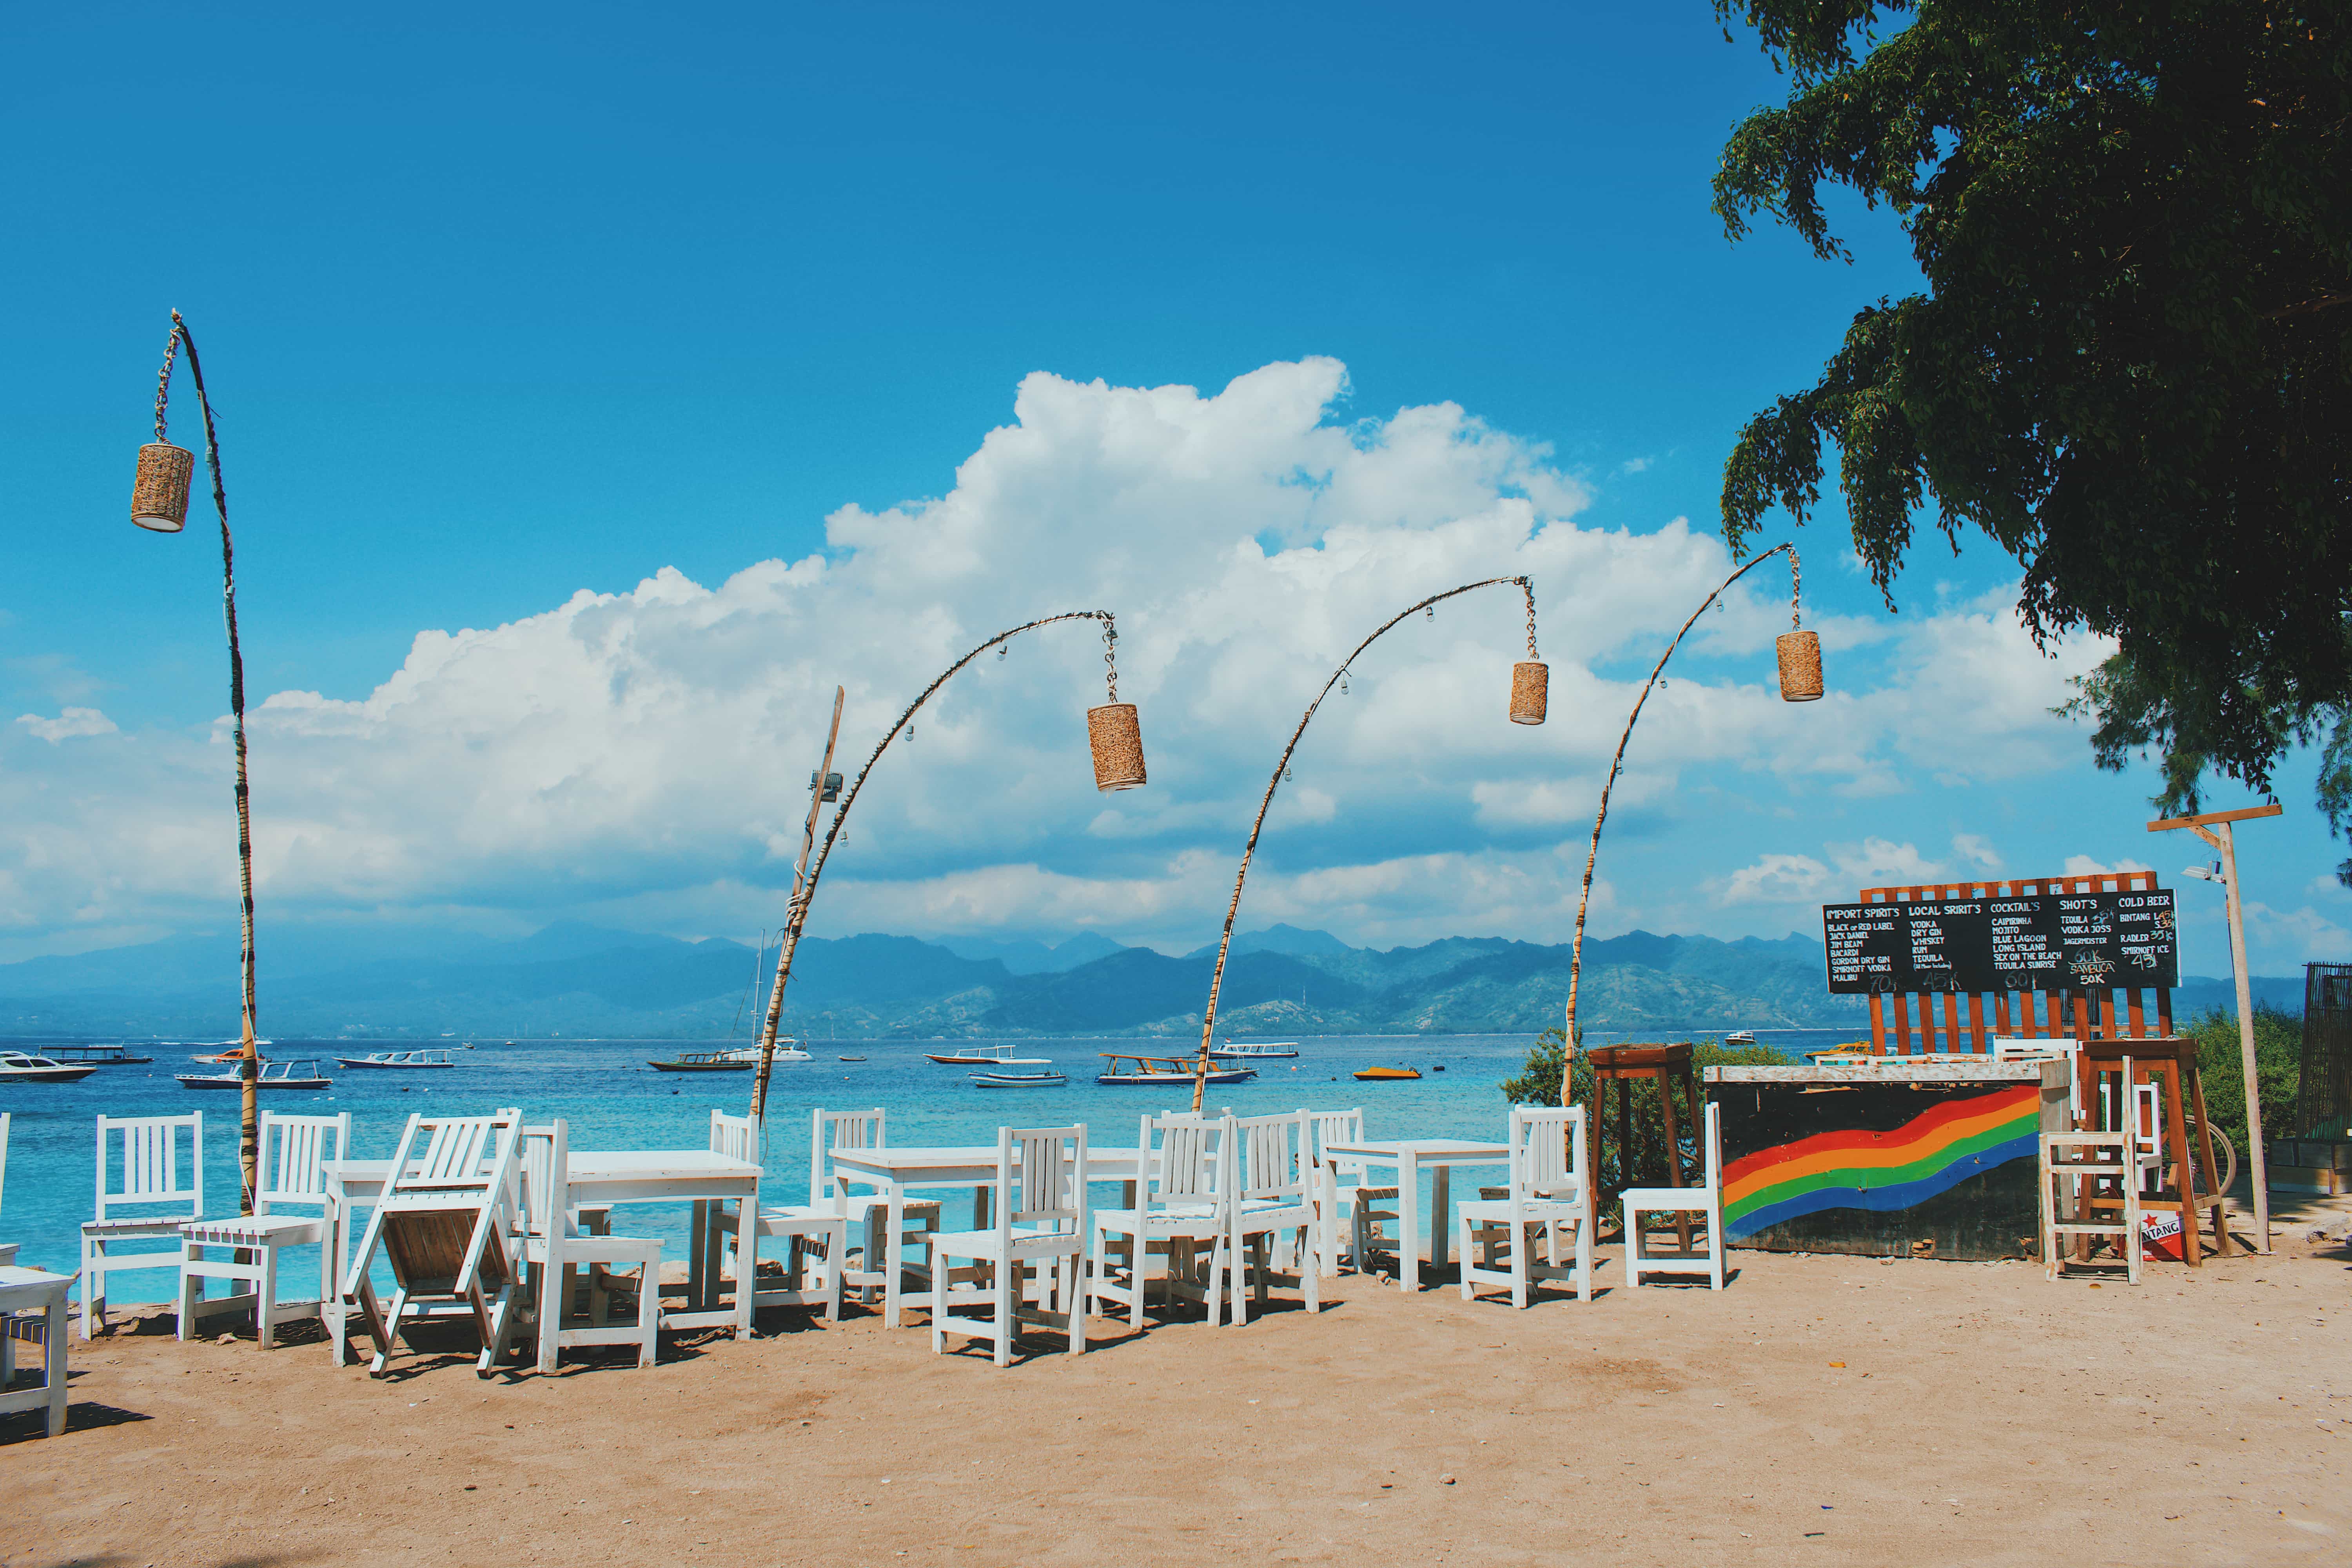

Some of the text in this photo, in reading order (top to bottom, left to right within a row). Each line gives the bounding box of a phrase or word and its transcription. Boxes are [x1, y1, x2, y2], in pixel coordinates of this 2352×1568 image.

[2059, 900, 2098, 910] SHOT'S
[2118, 896, 2171, 907] COLD BEER
[1908, 906, 1941, 916] LOCAL
[1990, 902, 2041, 913] COCKTAIL'S
[1826, 909, 1862, 919] IMPORT
[2120, 913, 2151, 922] BINTANG
[1991, 917, 2032, 926] CAIPIRINHA
[2060, 915, 2089, 924] TEQUILA
[1873, 922, 1895, 930] LABEL
[1992, 926, 2020, 935] MOJITO
[2060, 925, 2112, 934] VODKA JOSS
[1911, 937, 1945, 946] WHISKEY
[2120, 934, 2149, 942] RADLER
[1993, 943, 2046, 953] LONG ISLAND
[2121, 945, 2170, 955] SMIRNOFF ICE
[1830, 949, 1859, 957] BACARDI
[2038, 951, 2062, 960] BEACH
[1831, 957, 1859, 965] GORDON
[1912, 954, 1944, 962] TEQUILA
[1867, 964, 1892, 972] VODKA
[1994, 960, 2057, 970] TEQUILA SUNRISE
[2070, 963, 2116, 974] SAMBUCA
[2141, 1223, 2179, 1241] NTANG
